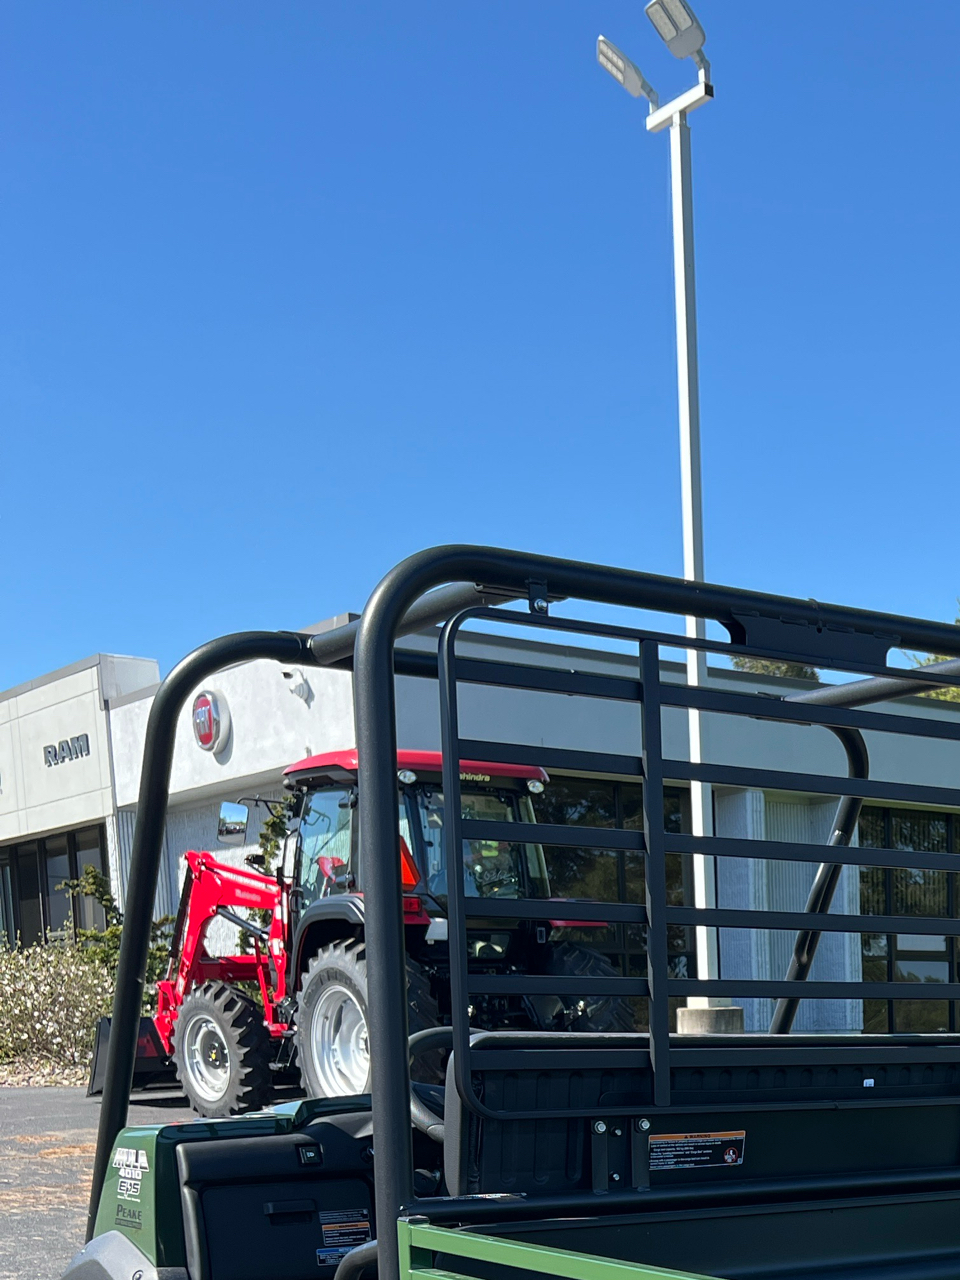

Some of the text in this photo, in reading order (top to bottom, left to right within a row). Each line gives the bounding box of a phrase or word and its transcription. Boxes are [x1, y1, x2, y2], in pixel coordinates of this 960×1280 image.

[43, 733, 91, 768] RAM
[459, 773, 491, 782] ahindra
[119, 1168, 142, 1180] 4010
